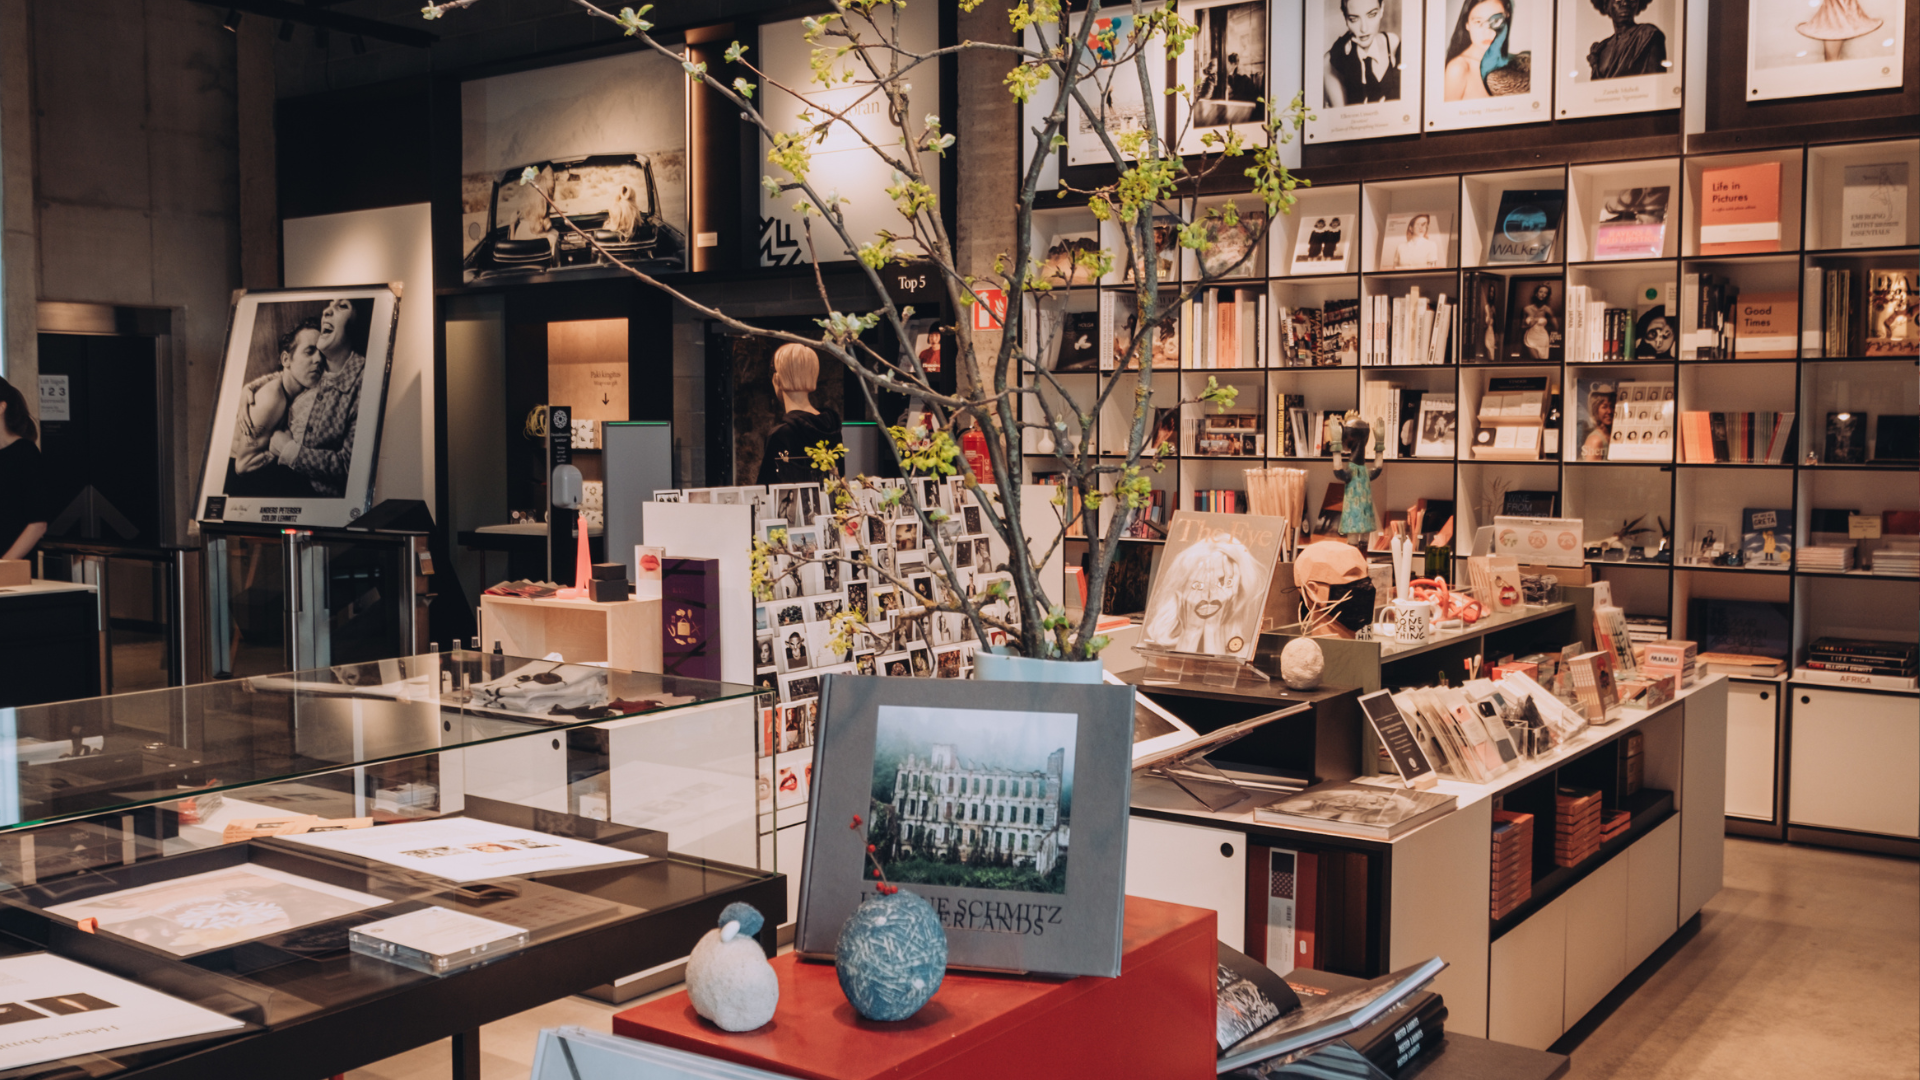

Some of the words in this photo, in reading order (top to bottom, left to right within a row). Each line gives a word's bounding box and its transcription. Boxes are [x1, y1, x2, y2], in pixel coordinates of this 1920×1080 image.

[1712, 181, 1729, 192] Life
[1731, 181, 1740, 191] in
[1712, 193, 1748, 203] Pictures
[1850, 229, 1890, 237] ESSENTIALS
[898, 276, 918, 293] Top
[919, 276, 926, 289] 5
[1744, 306, 1772, 316] Good
[1323, 318, 1359, 337] MAGN
[1744, 318, 1771, 327] Times
[41, 387, 44, 396] 1
[48, 387, 55, 396] 2
[59, 387, 66, 396] 3
[1508, 494, 1530, 503] WINE
[278, 507, 302, 515] PETERSEN
[1506, 503, 1532, 511] FROM
[261, 514, 277, 522] COLOR
[1753, 517, 1776, 526] GRETA
[1177, 517, 1224, 544] The
[1229, 520, 1273, 548] Eye
[1650, 655, 1677, 663] MAMA!
[1840, 675, 1872, 685] AFRICA
[957, 899, 1063, 925] SCHMITZ
[940, 911, 1044, 936] ERLANDS
[60, 1025, 120, 1038] Helene
